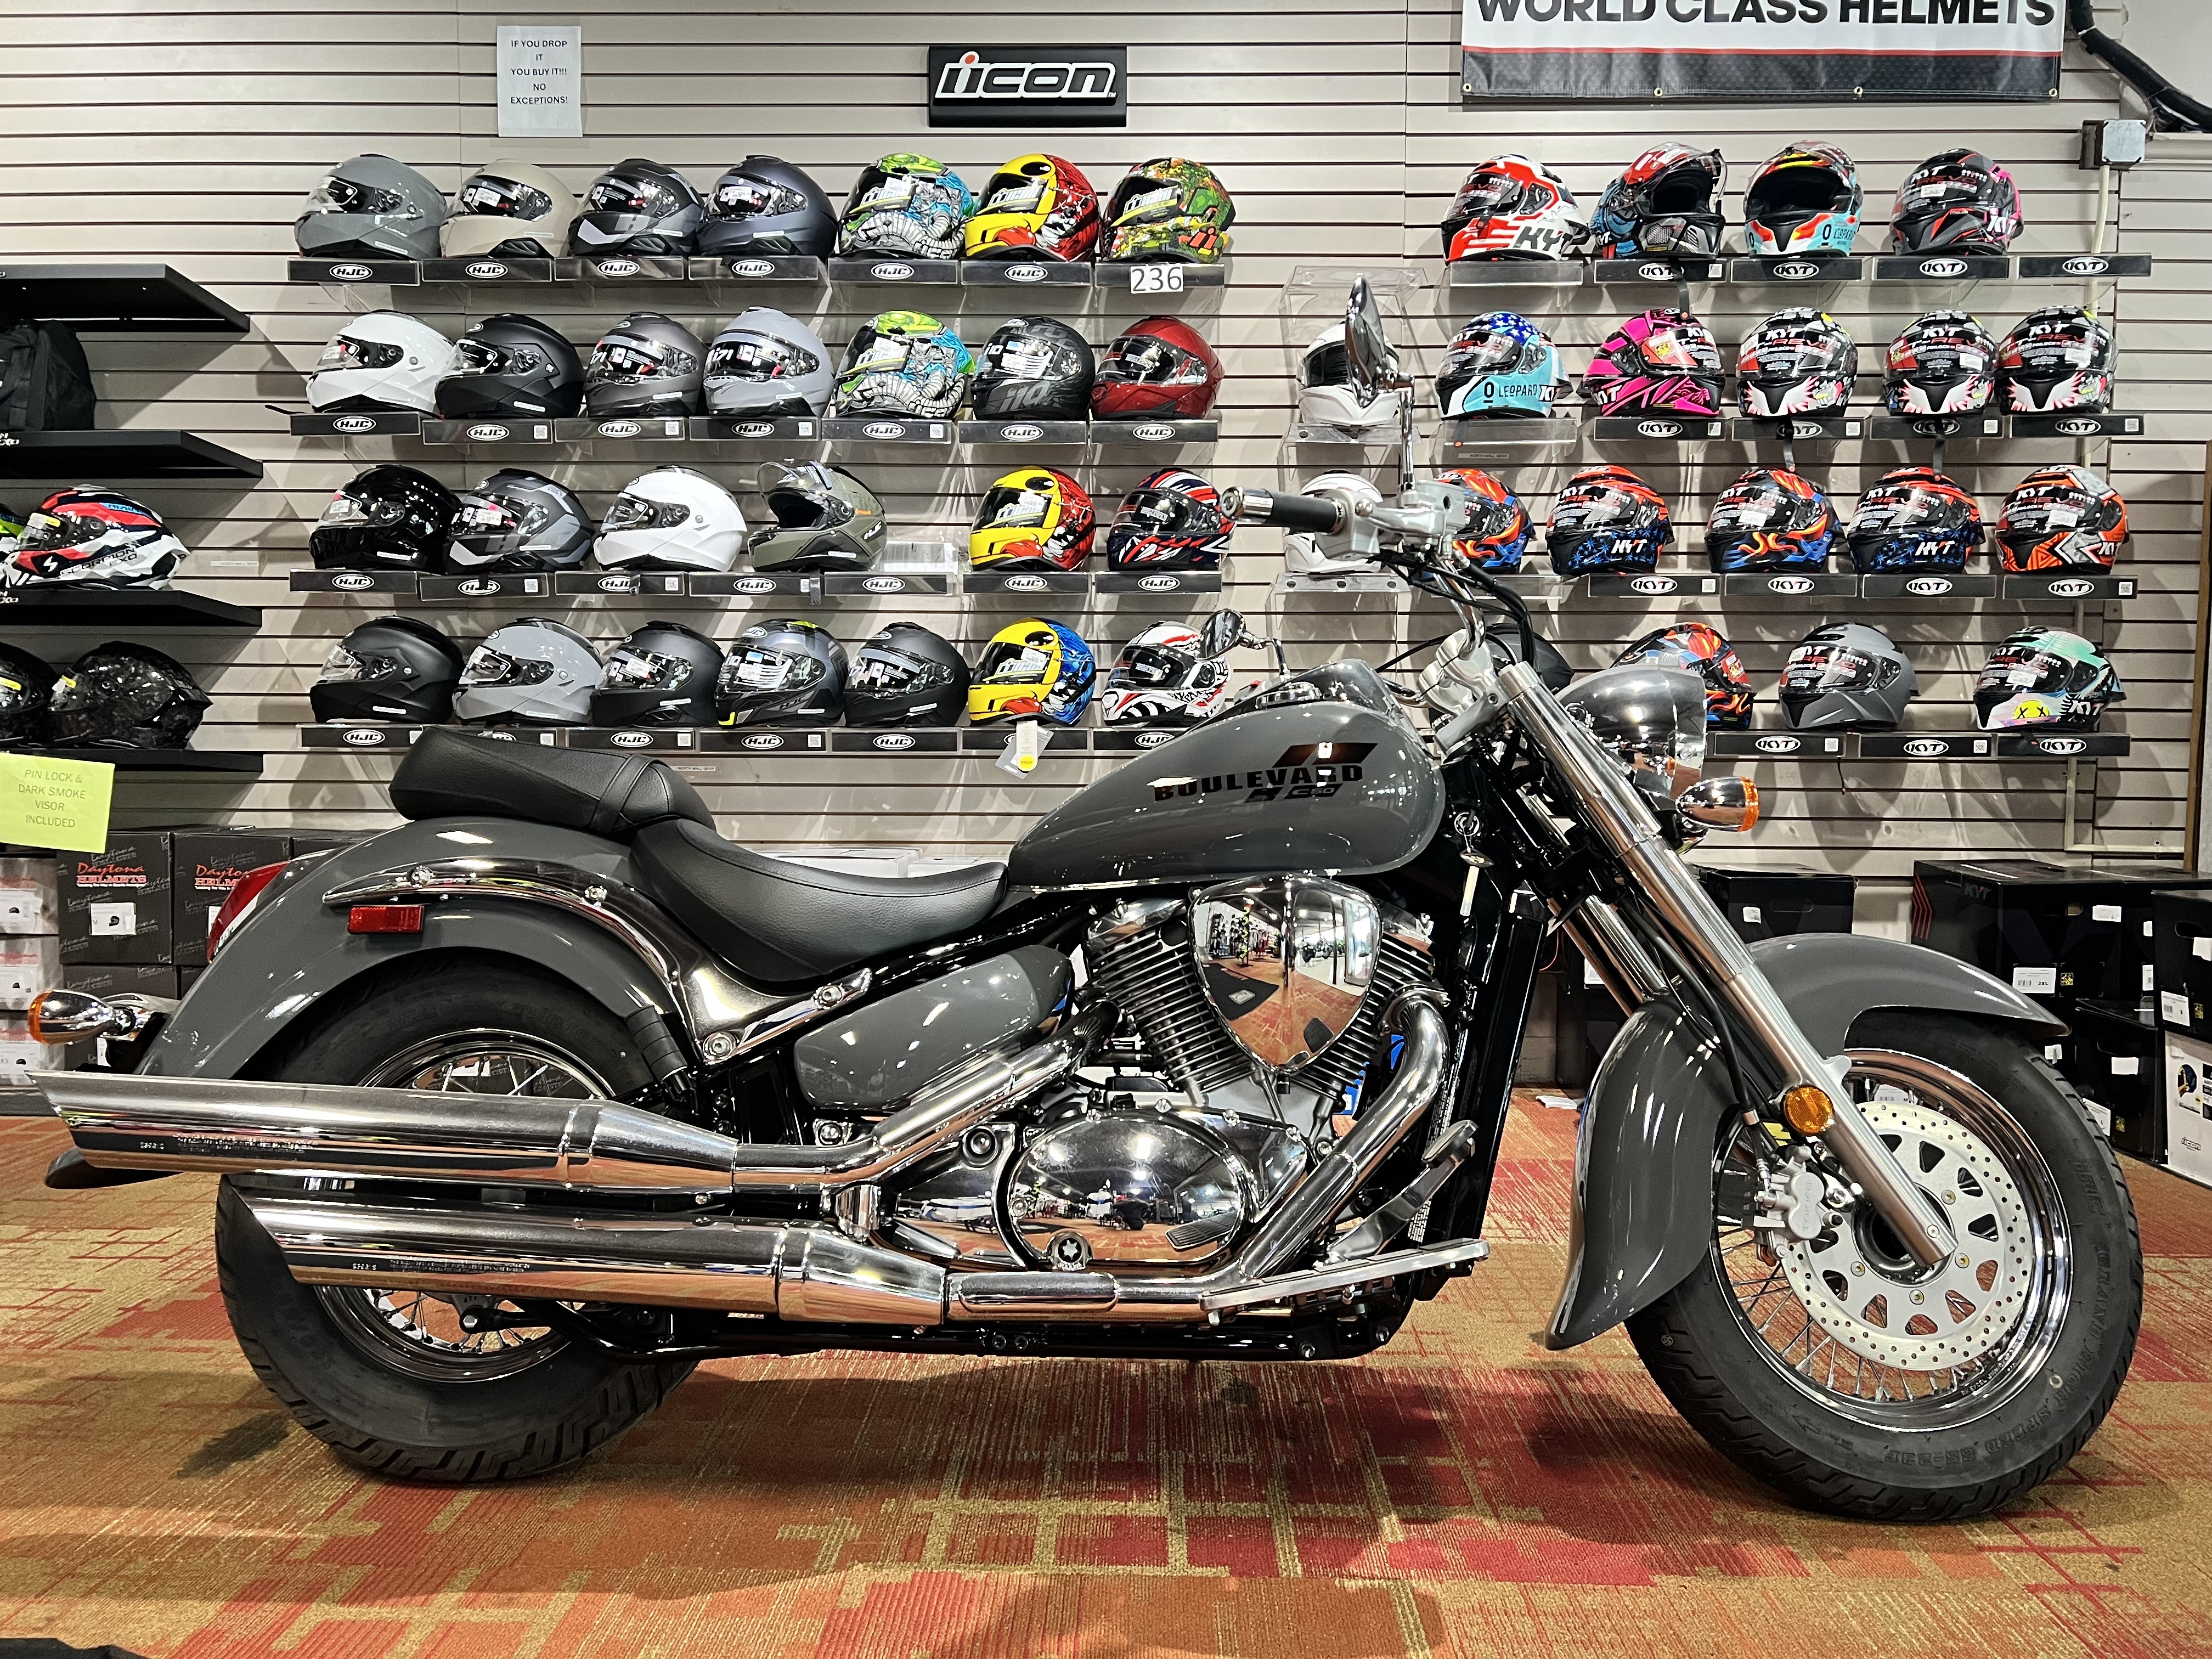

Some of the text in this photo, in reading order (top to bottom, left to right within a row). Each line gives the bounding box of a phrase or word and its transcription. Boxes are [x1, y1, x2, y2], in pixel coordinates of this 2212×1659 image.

[533, 83, 546, 91] NO
[510, 96, 568, 104] EXCEPTIONS!
[1779, 266, 1813, 275] KYT
[1927, 263, 1960, 272] KYT
[2069, 262, 2102, 270] KYT
[1132, 267, 1182, 292] 236
[1922, 326, 1962, 338] KYT
[2030, 324, 2070, 336] KYT
[1499, 384, 1537, 397] LEOPARD
[1644, 424, 1678, 432] KYT
[2061, 422, 2095, 431] KYT
[2016, 486, 2054, 500] KYT
[60, 548, 135, 575] SCORPION
[1638, 580, 1671, 589] KYT
[1775, 581, 1808, 589] KYT
[1913, 582, 1946, 590] KYT
[2056, 584, 2088, 592] KYT
[779, 696, 806, 709] HJC
[1762, 740, 1795, 748] KYT
[1910, 743, 1943, 752] KYT
[2046, 741, 2080, 750] KYT
[24, 770, 82, 783] PIN LOCK &
[1154, 765, 1363, 802] BOULEVARD
[19, 784, 86, 799] DARK SMOKE
[1291, 787, 1335, 795] C50
[35, 800, 65, 811] VISOR
[26, 815, 76, 827] INCLUDED
[77, 862, 144, 876] Daytona
[196, 864, 247, 881] Dayto
[77, 875, 147, 883] HELMETS
[195, 878, 238, 887] HELM
[1964, 882, 1993, 900] KYT
